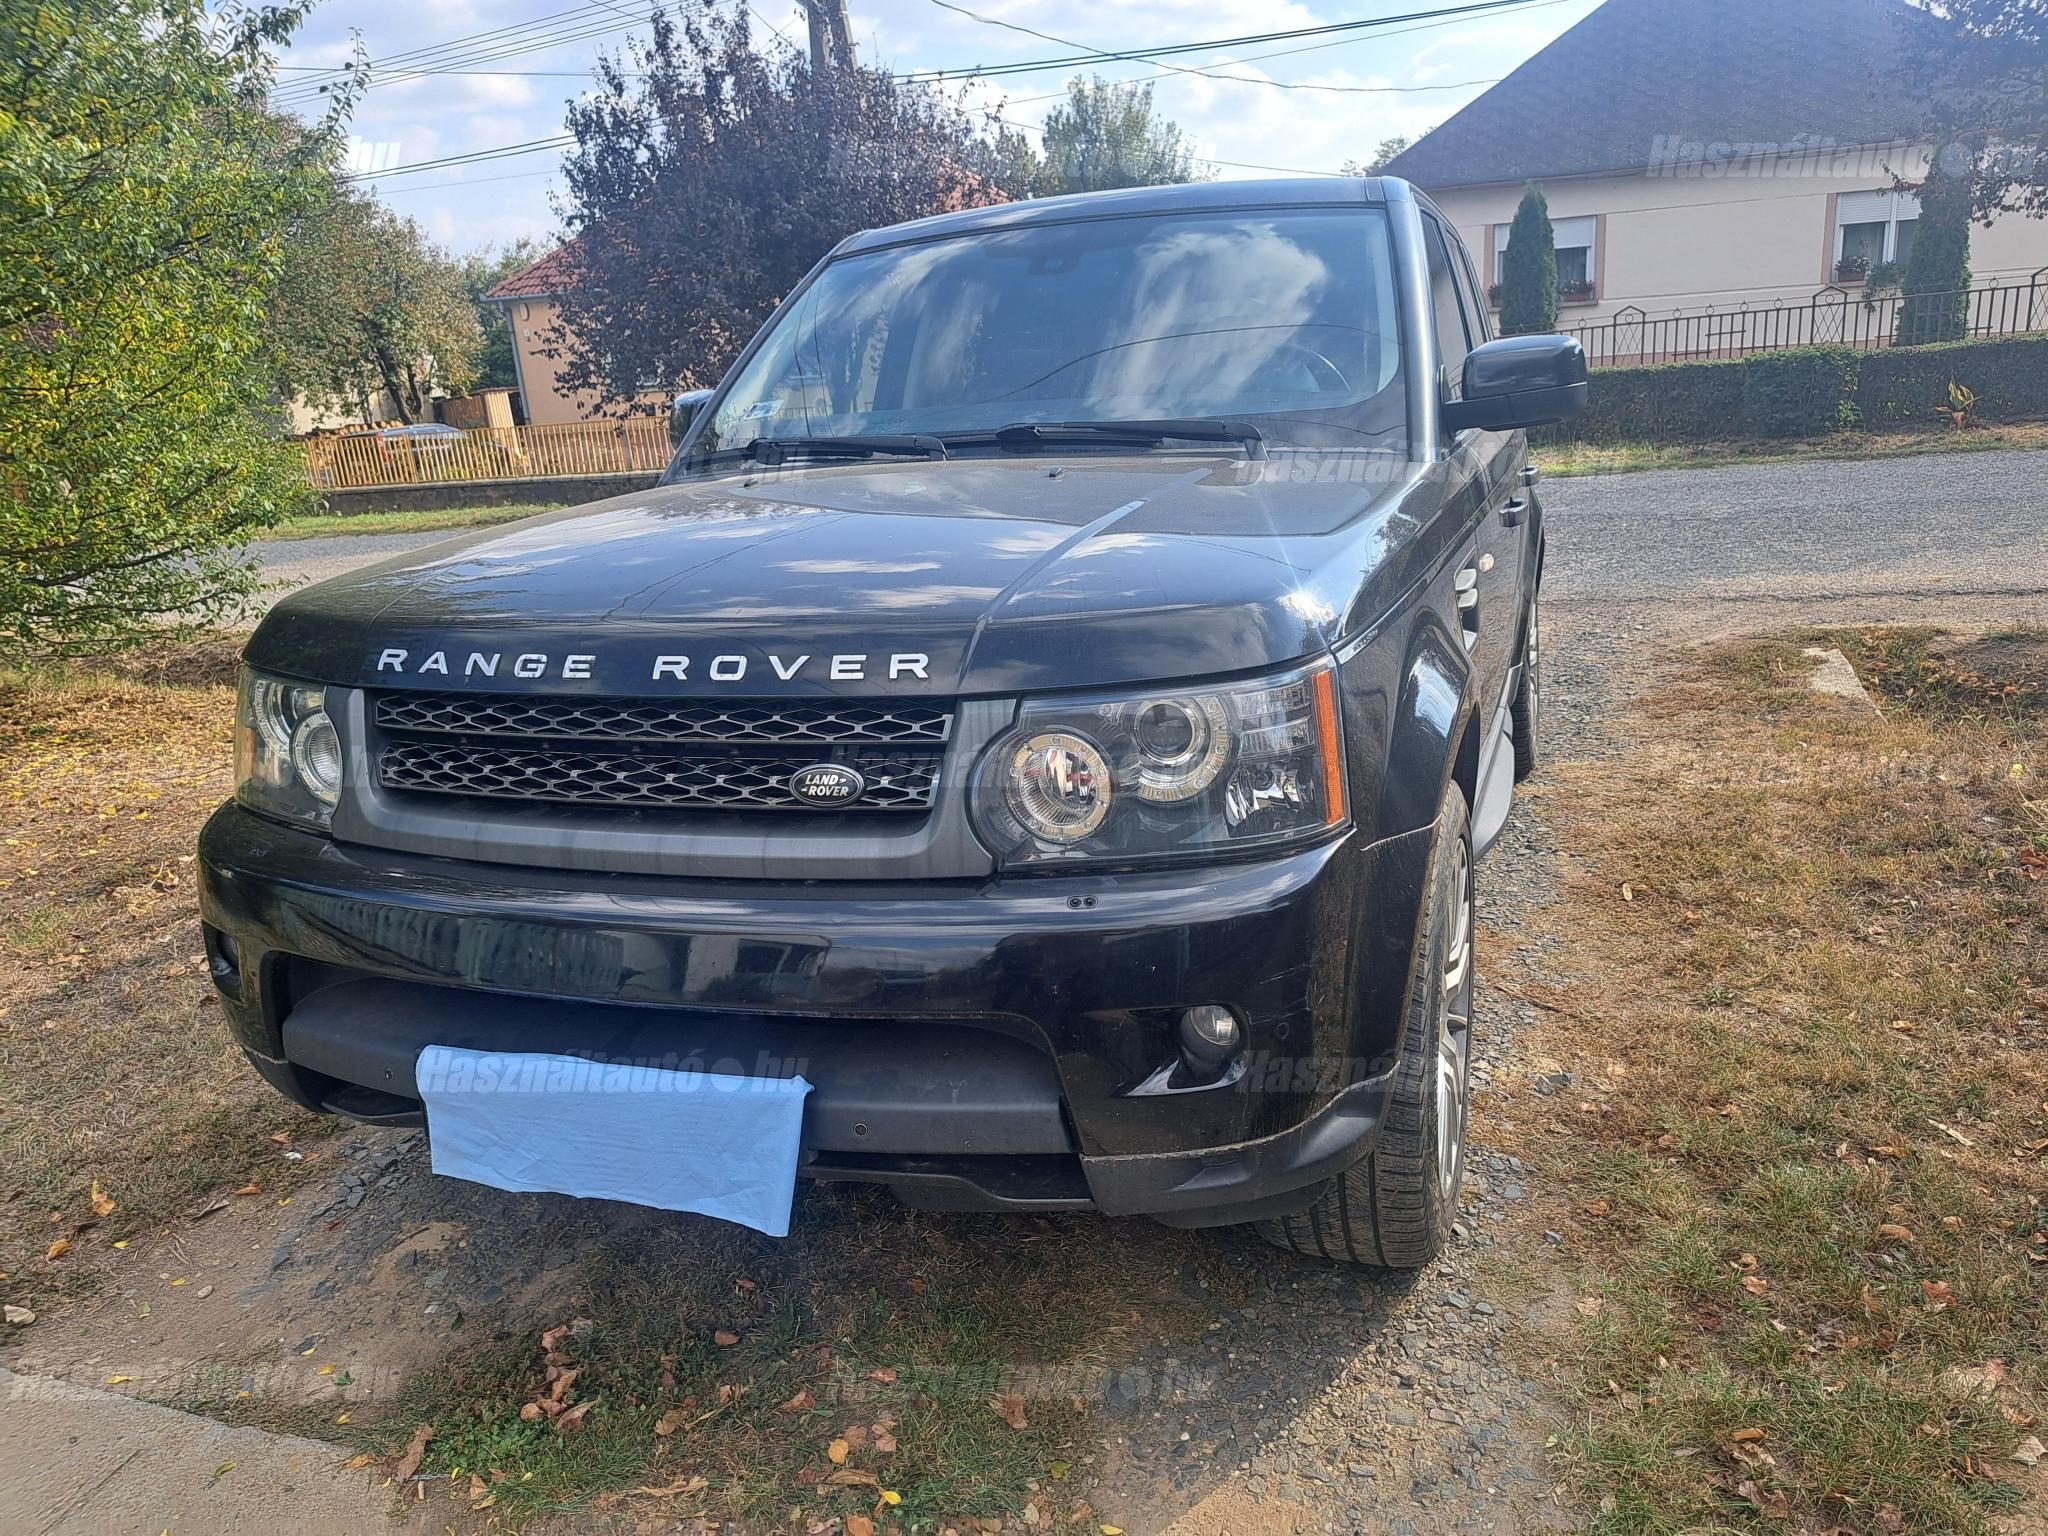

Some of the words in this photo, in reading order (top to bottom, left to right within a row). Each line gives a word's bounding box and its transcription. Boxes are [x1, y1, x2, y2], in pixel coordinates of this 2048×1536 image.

[376, 648, 597, 681] RANGE
[652, 652, 930, 682] ROVER
[805, 774, 839, 786] LAND
[807, 785, 849, 797] ROVER
